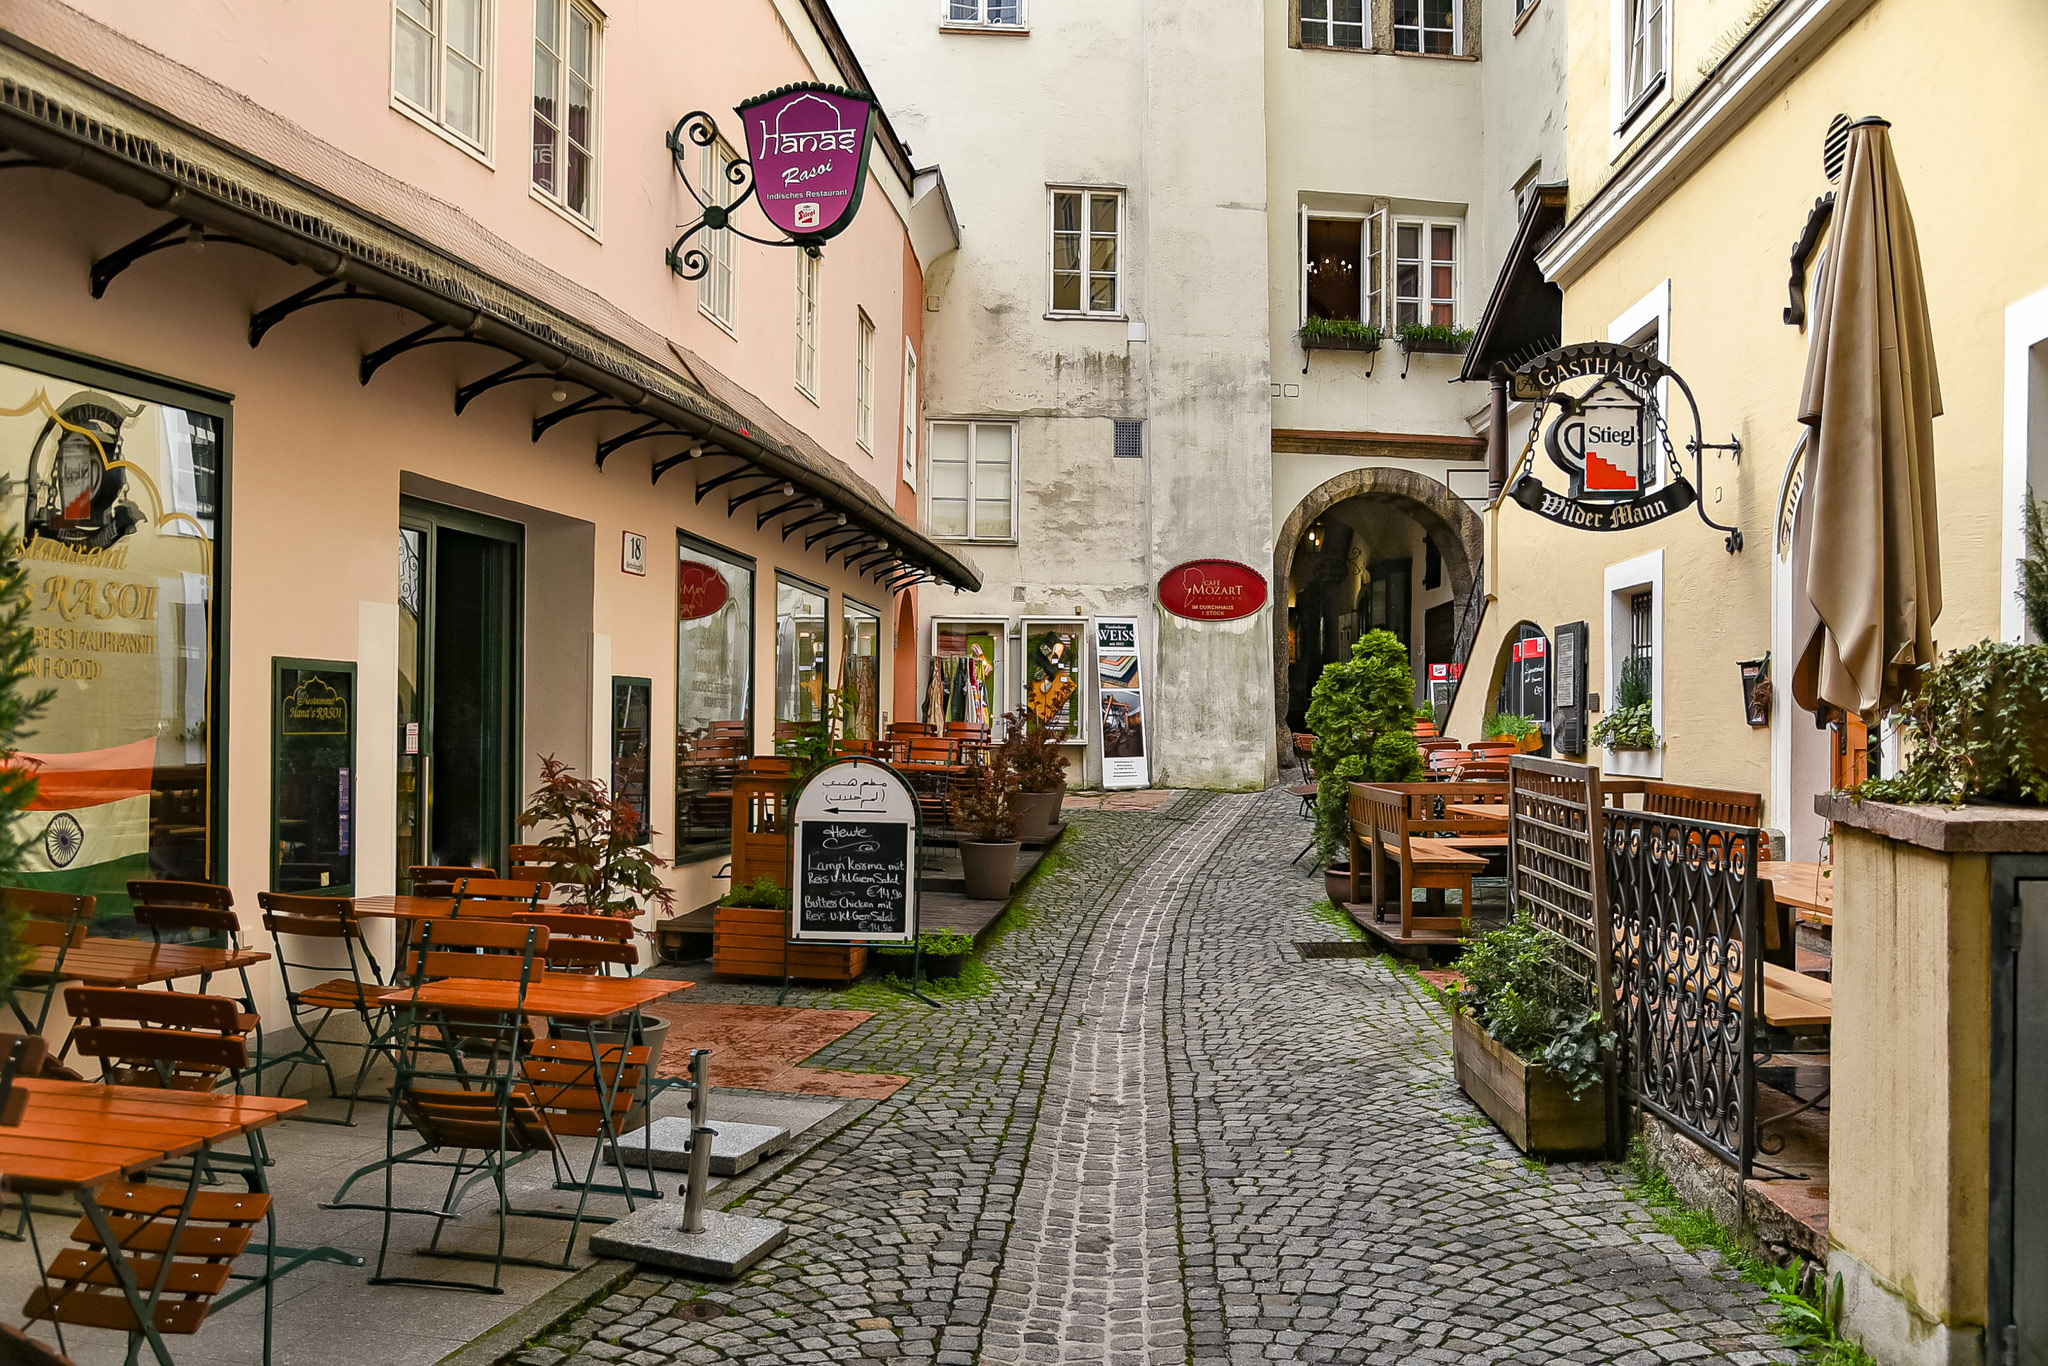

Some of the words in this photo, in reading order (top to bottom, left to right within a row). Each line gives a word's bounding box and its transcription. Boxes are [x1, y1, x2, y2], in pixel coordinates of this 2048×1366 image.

[758, 120, 857, 160] Hanas
[781, 159, 833, 188] Rasoi
[766, 192, 804, 201] Indisches
[805, 188, 848, 199] Restaurant
[1538, 357, 1651, 388] GASTHAUS
[1588, 425, 1636, 447] Stiegl
[1540, 493, 1603, 527] Wilder
[1609, 499, 1668, 529] Mann
[14, 528, 129, 571] staurant
[630, 536, 642, 561] 18
[41, 574, 160, 622] RASOI
[1192, 584, 1243, 595] MOZART
[1097, 629, 1136, 641] WEISS
[316, 706, 342, 720] RASOI
[823, 825, 873, 838] Heute
[888, 860, 905, 870] mit
[839, 896, 874, 908] Chicken
[878, 900, 894, 910] mit
